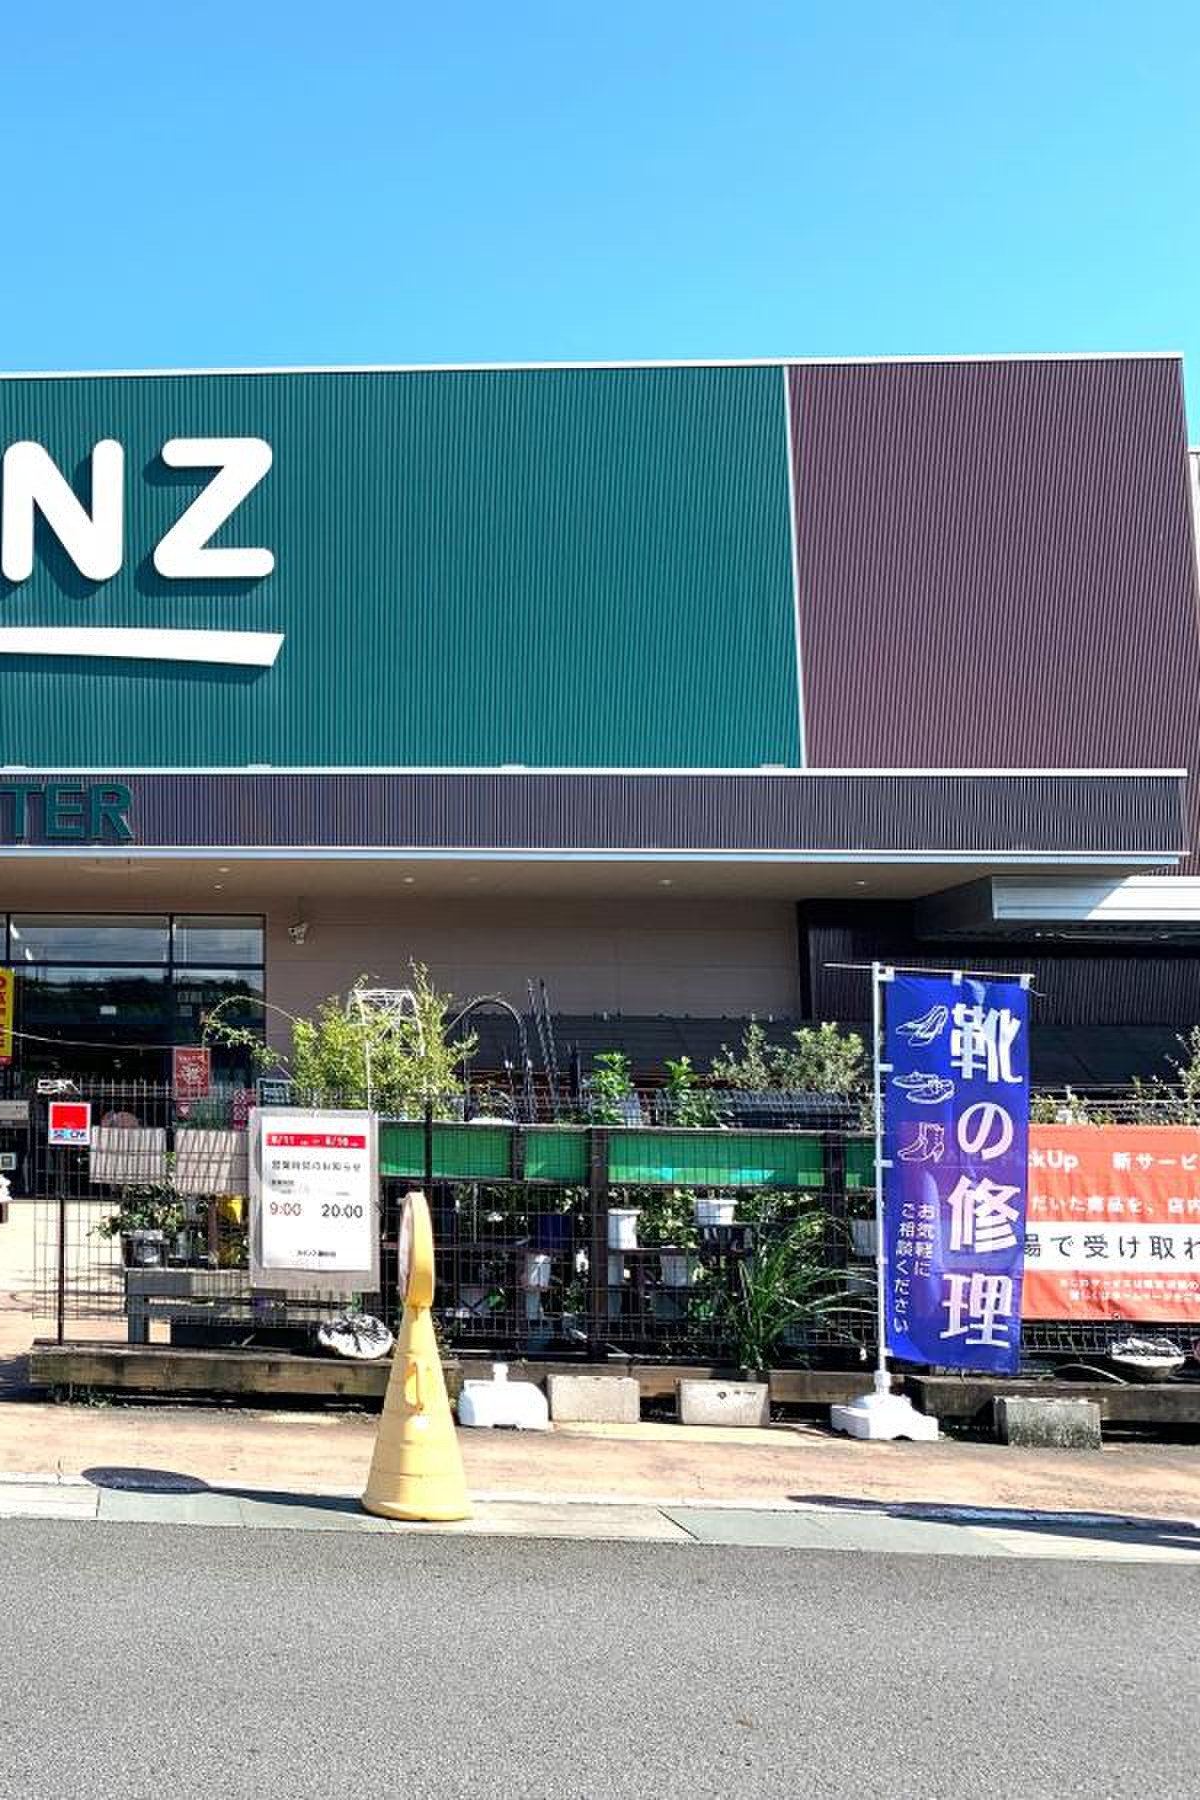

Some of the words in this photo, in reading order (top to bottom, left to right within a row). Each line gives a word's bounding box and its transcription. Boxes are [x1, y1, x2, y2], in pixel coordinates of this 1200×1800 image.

[270, 1202, 302, 1217] 9:00
[321, 1204, 364, 1219] 20:00
[940, 1003, 1023, 1349] 靴の修理
[893, 1203, 918, 1333] ご相談ください
[913, 1203, 938, 1278] お気軽に
